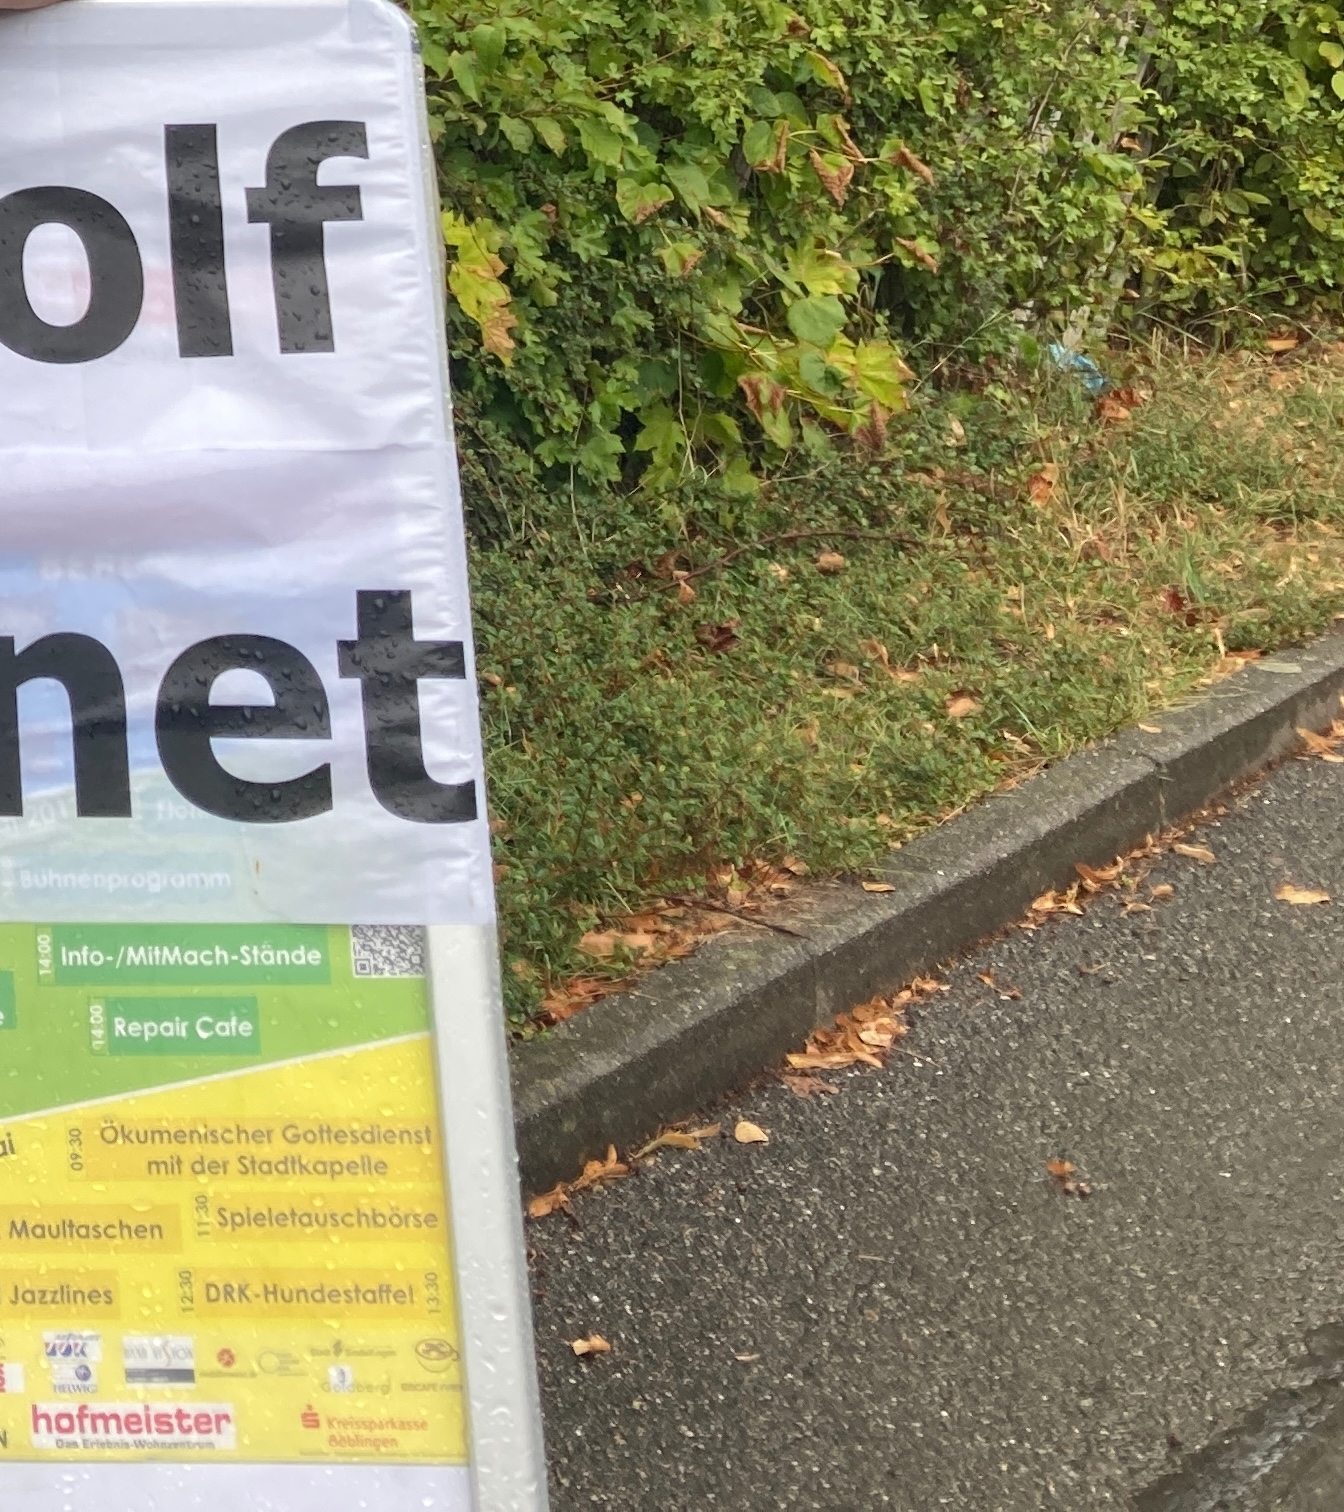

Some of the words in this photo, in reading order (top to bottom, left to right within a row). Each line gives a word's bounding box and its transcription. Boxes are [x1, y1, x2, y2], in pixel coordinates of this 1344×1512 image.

[37, 934, 52, 975] 14:00
[113, 1015, 189, 1041] Repair
[99, 1118, 274, 1146] Ökumenischer
[282, 1123, 433, 1146] Gottesdienst
[68, 1127, 84, 1172] 09:30
[147, 1155, 183, 1176] mit
[191, 1155, 230, 1176] der
[237, 1155, 389, 1180] Stadtkapelle
[8, 1218, 165, 1240] Maultaschen
[216, 1205, 440, 1232] Spieletauschbörse
[8, 1284, 114, 1307] Jazzlines
[205, 1282, 415, 1306] DRK-Hundestaffel
[31, 1403, 231, 1434] hofmeister
[326, 1416, 429, 1433] Kreissparkasse
